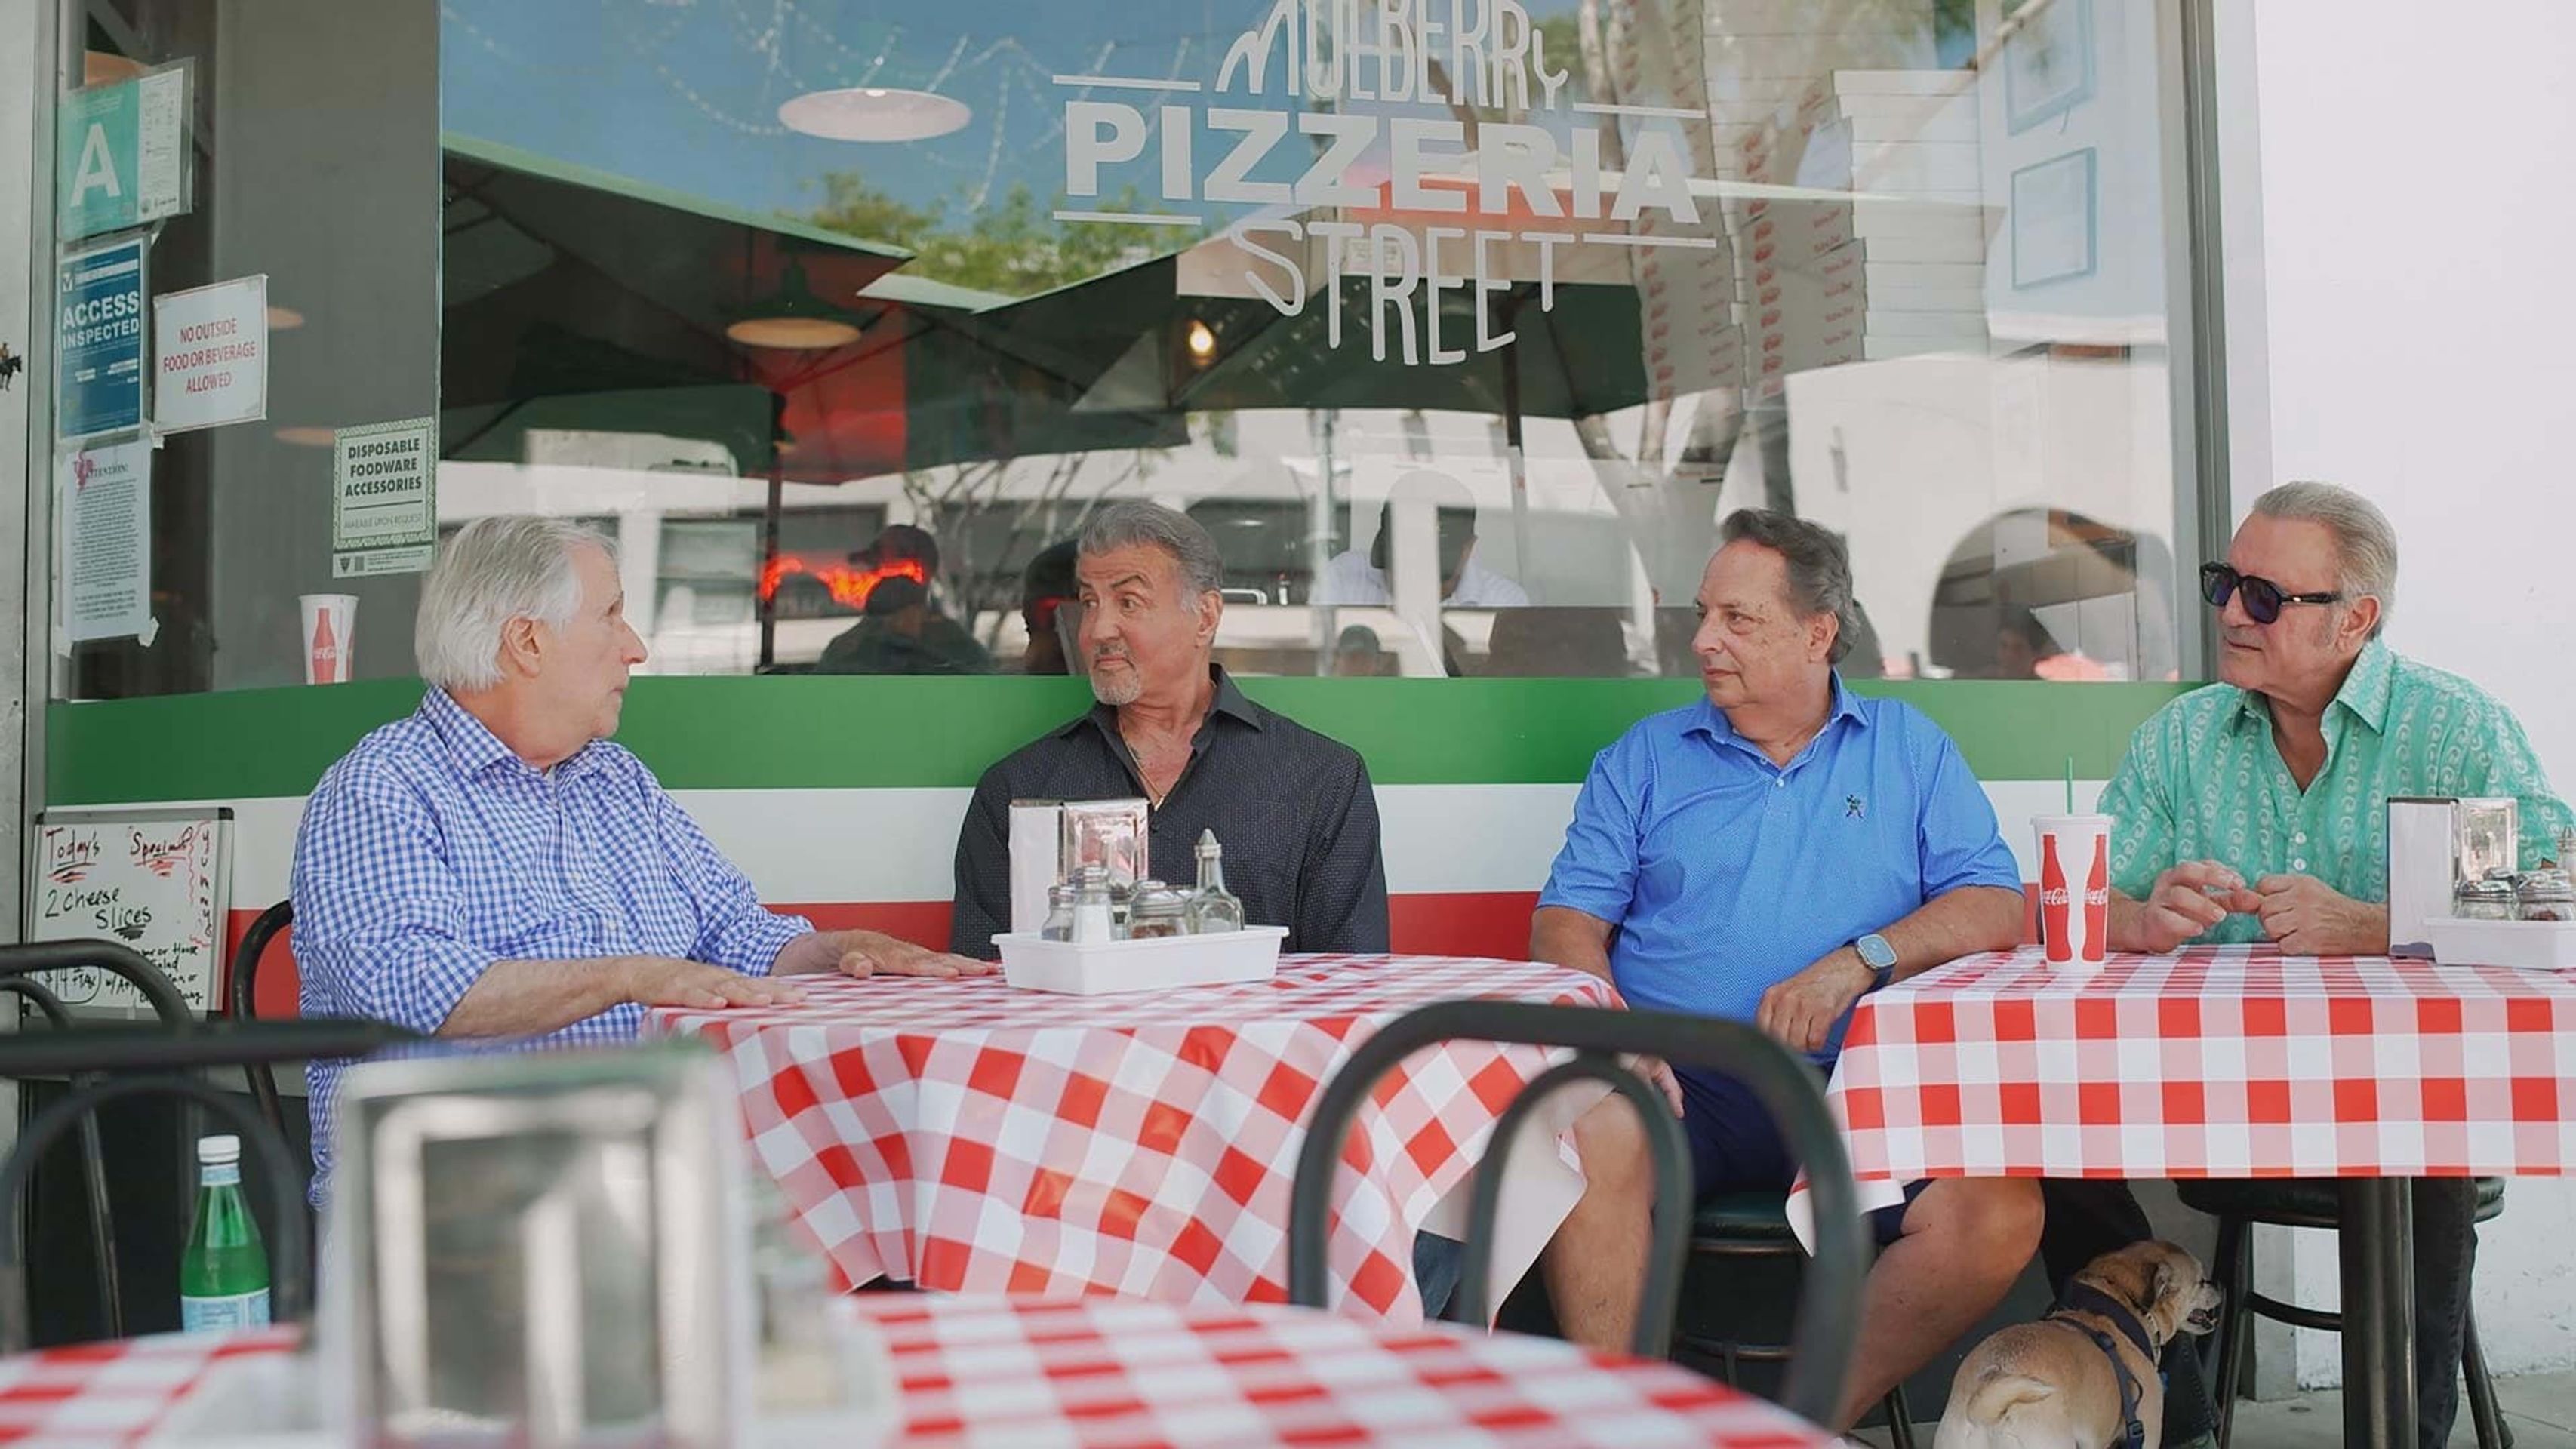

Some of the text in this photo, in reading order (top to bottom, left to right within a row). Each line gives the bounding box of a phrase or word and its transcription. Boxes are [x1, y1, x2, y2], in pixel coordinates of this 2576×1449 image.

[1215, 0, 1568, 110] MULBERRY
[69, 122, 121, 208] A
[1065, 101, 1702, 224] PIZZERIA
[1230, 219, 1575, 366] STREET
[63, 290, 140, 330] ACCESS
[63, 318, 140, 350] INSPECTED
[180, 318, 237, 343] NO OUTSIDE
[163, 341, 256, 373] FOOD OR BEVERAGE
[186, 371, 231, 394] ALLOWED
[348, 438, 420, 459] DISPOSABLE
[350, 457, 417, 478] FOODWARE
[345, 476, 422, 497] ACCESSORIES
[45, 826, 100, 870] Today's
[45, 889, 60, 918] 2
